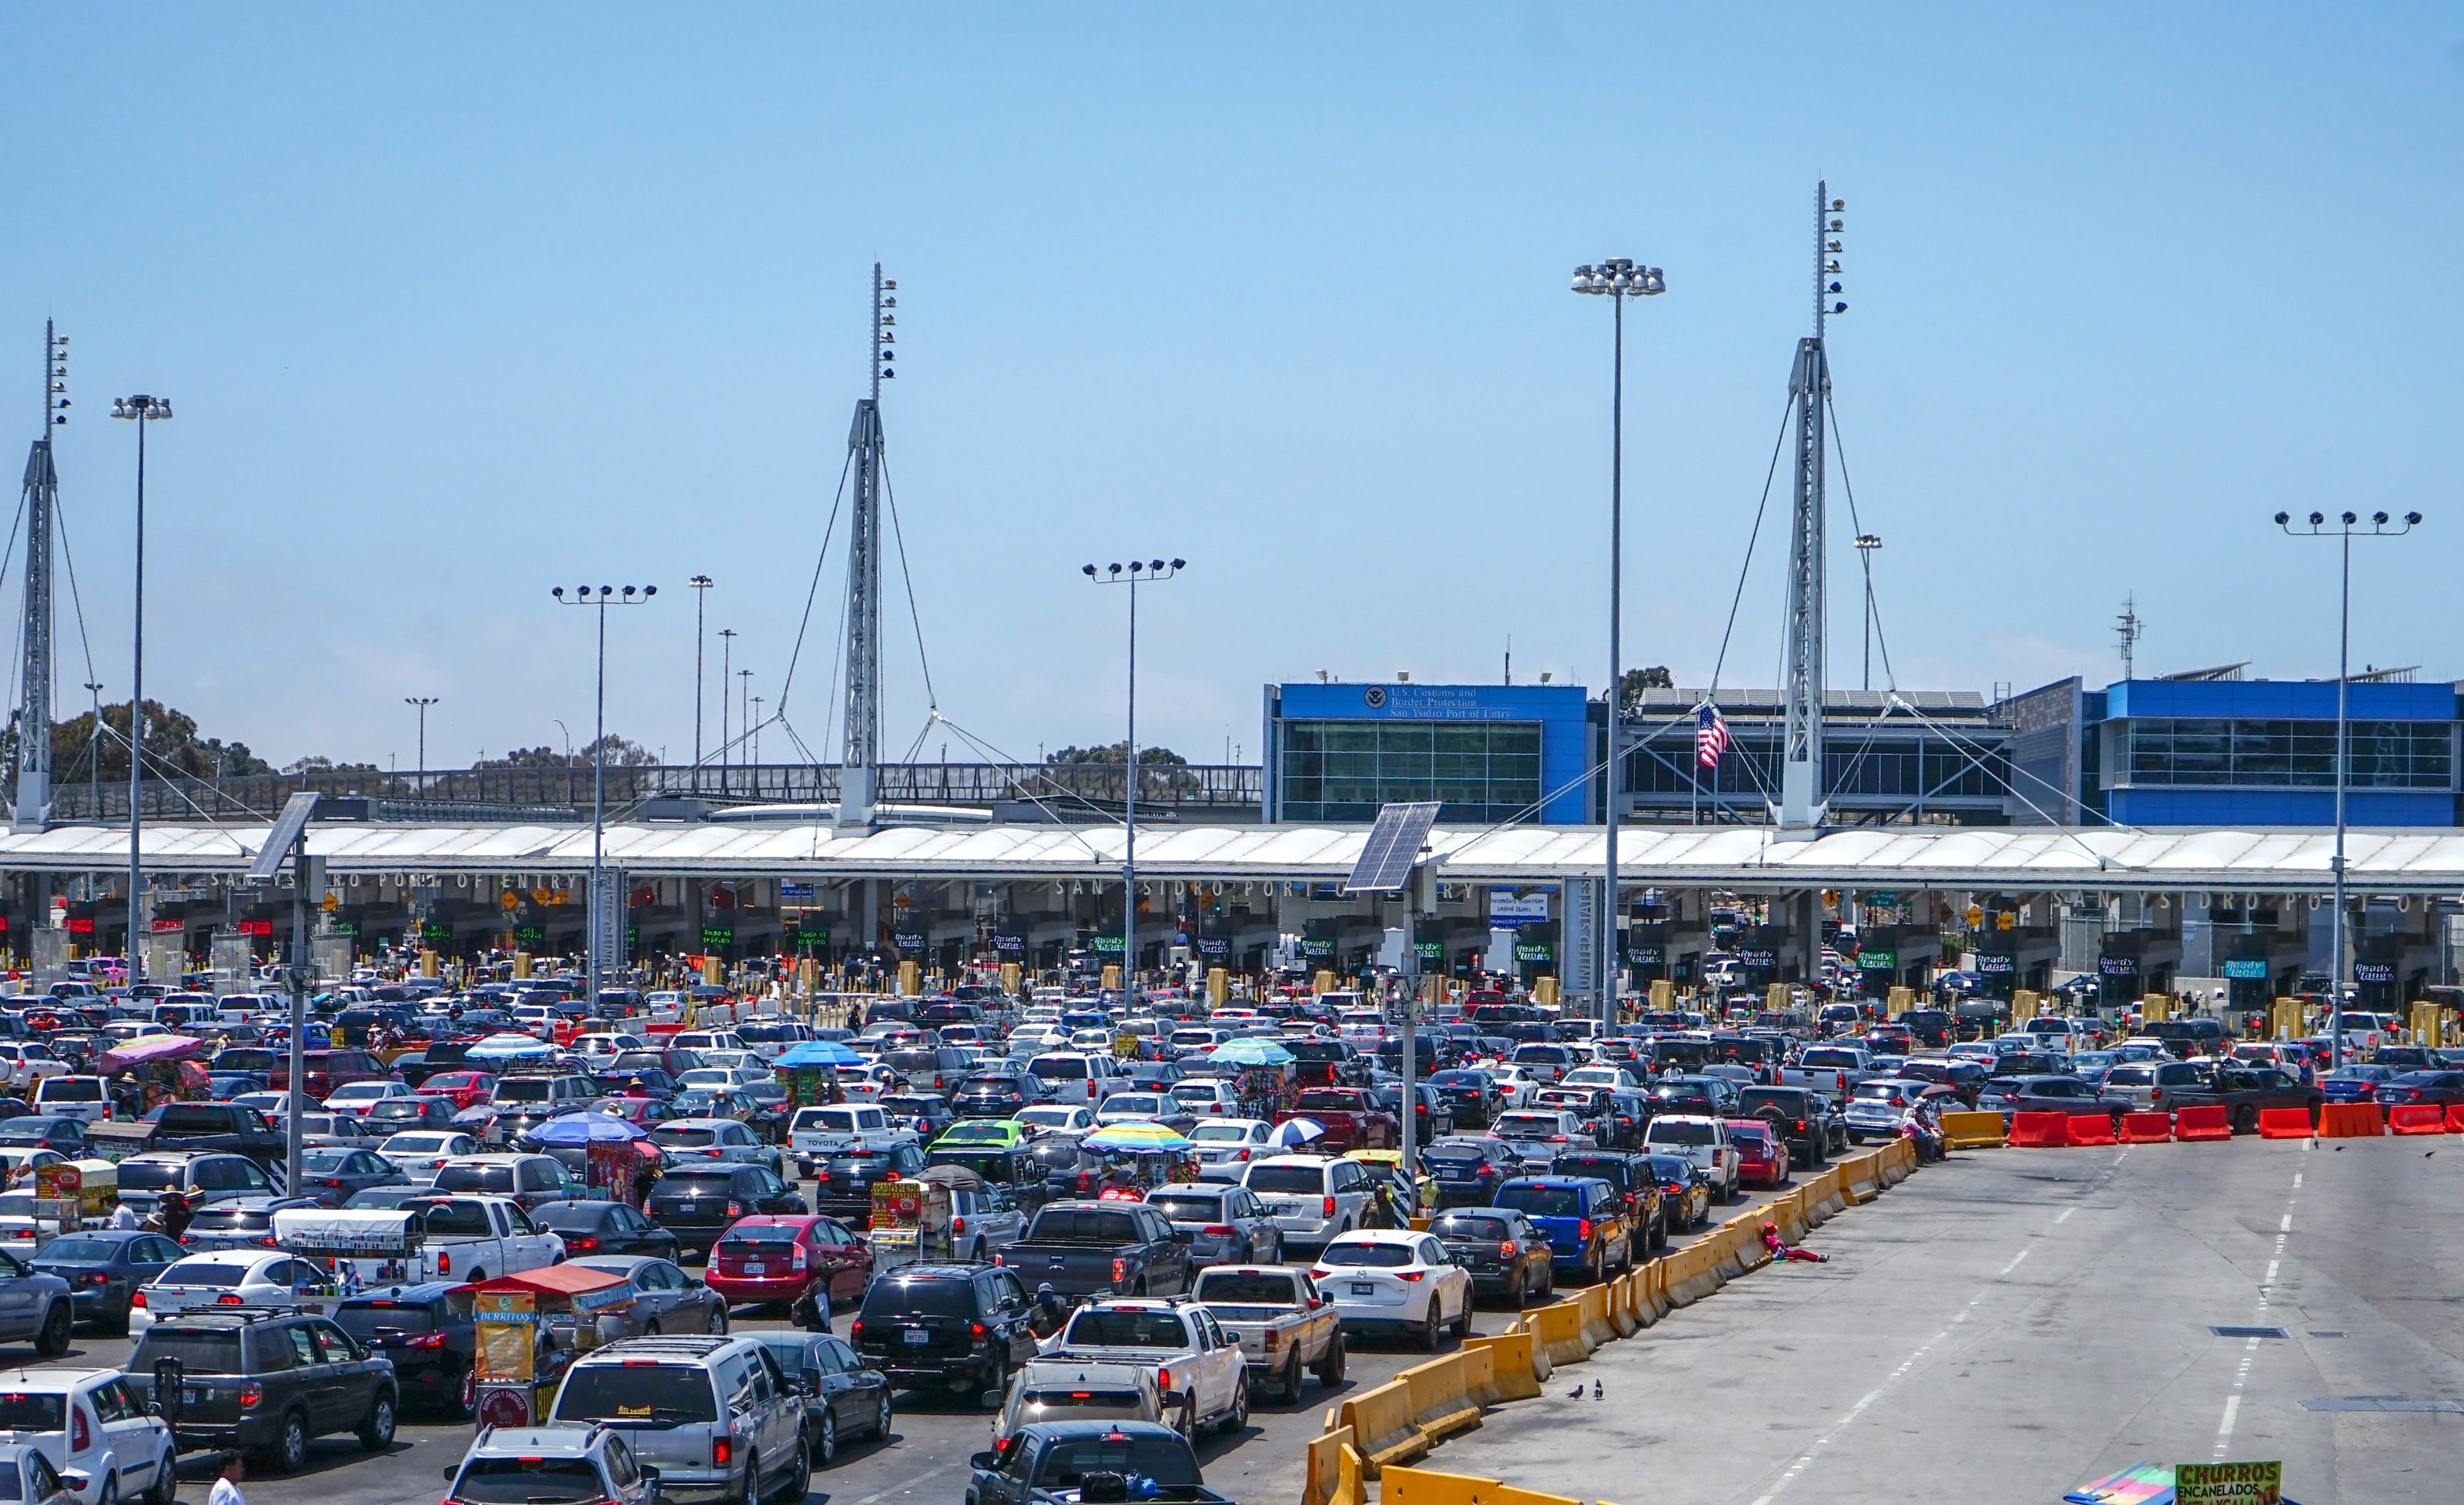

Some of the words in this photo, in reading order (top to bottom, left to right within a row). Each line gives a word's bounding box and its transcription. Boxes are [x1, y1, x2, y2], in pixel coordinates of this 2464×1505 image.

[1391, 688, 1410, 697] U.S.
[1414, 688, 1455, 697] Customs
[1459, 688, 1476, 697] and
[1391, 698, 1424, 707] Border
[1428, 698, 1477, 707] Protection
[1391, 709, 1408, 718] San
[1413, 709, 1443, 718] Ysidro
[1447, 709, 1465, 719] Port
[1469, 709, 1478, 719] of
[1484, 709, 1511, 719] Entry
[457, 873, 484, 888] OF
[502, 873, 577, 889] ENTRY
[1056, 880, 1103, 895] SAN
[1143, 880, 1224, 895] SIDRO
[1579, 880, 1592, 930] STATES
[2054, 890, 2111, 908] SAN
[2138, 891, 2260, 910] YSIDRO
[2286, 893, 2369, 912] POT
[2397, 893, 2433, 912] OF
[1579, 935, 1591, 988] UNITED
[1744, 957, 1769, 966] Lane
[1858, 953, 1890, 961] Ready
[1977, 955, 2010, 964] Ready
[2100, 957, 2134, 967] Ready
[1981, 963, 2006, 971] Lane
[2104, 965, 2130, 974] Lane
[2355, 964, 2391, 974] Ready
[2360, 973, 2387, 981] Lane
[873, 1182, 898, 1193] GORDITAS
[899, 1183, 905, 1192] DE
[907, 1183, 920, 1193] NATA
[480, 1312, 531, 1322] BURRITOS
[482, 1392, 500, 1411] BURRITOS
[506, 1392, 525, 1411] TAMALES
[2180, 1463, 2278, 1485] CHURROS
[2177, 1483, 2259, 1498] ENCANELADOS
